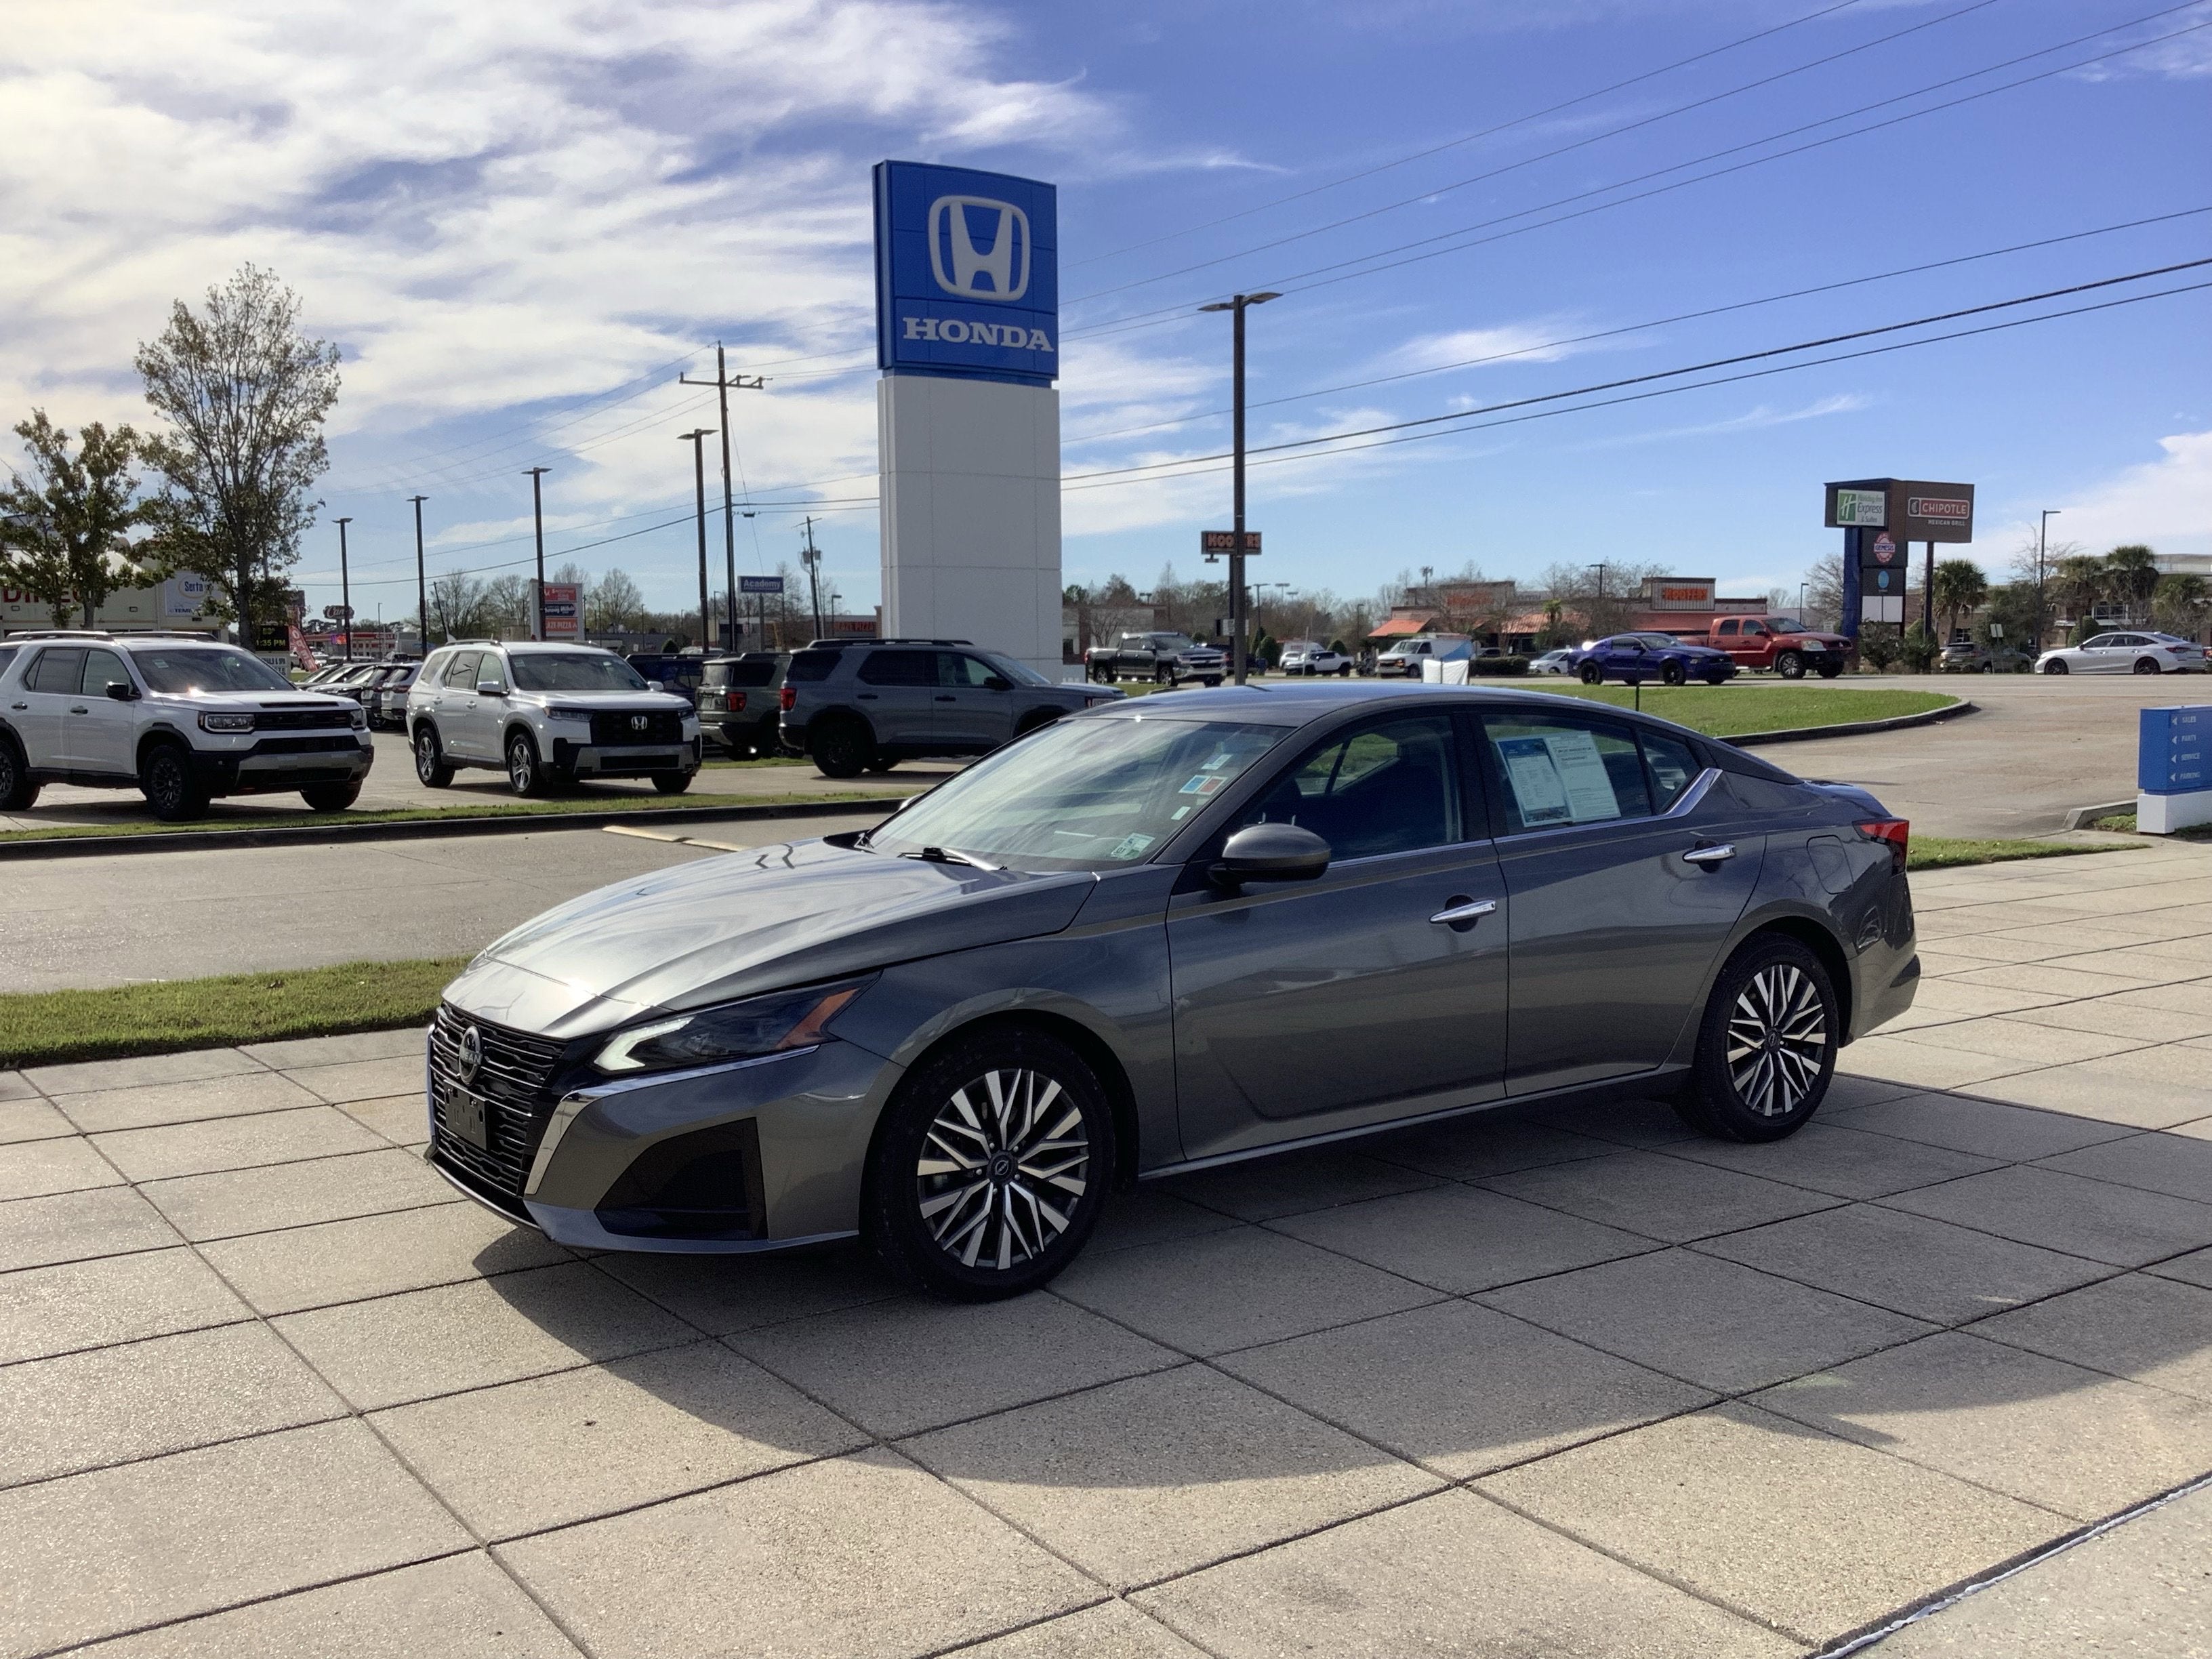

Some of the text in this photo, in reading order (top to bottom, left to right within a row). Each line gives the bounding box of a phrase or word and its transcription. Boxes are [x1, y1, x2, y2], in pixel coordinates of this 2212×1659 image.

[903, 317, 1054, 352] HONDA
[1858, 502, 1883, 515] Express
[1922, 503, 1967, 514] CHIPOTLE
[1208, 533, 1258, 548] HOORS
[184, 581, 204, 592] Serta
[743, 579, 781, 590] Academy
[2181, 752, 2201, 760] SERVICE
